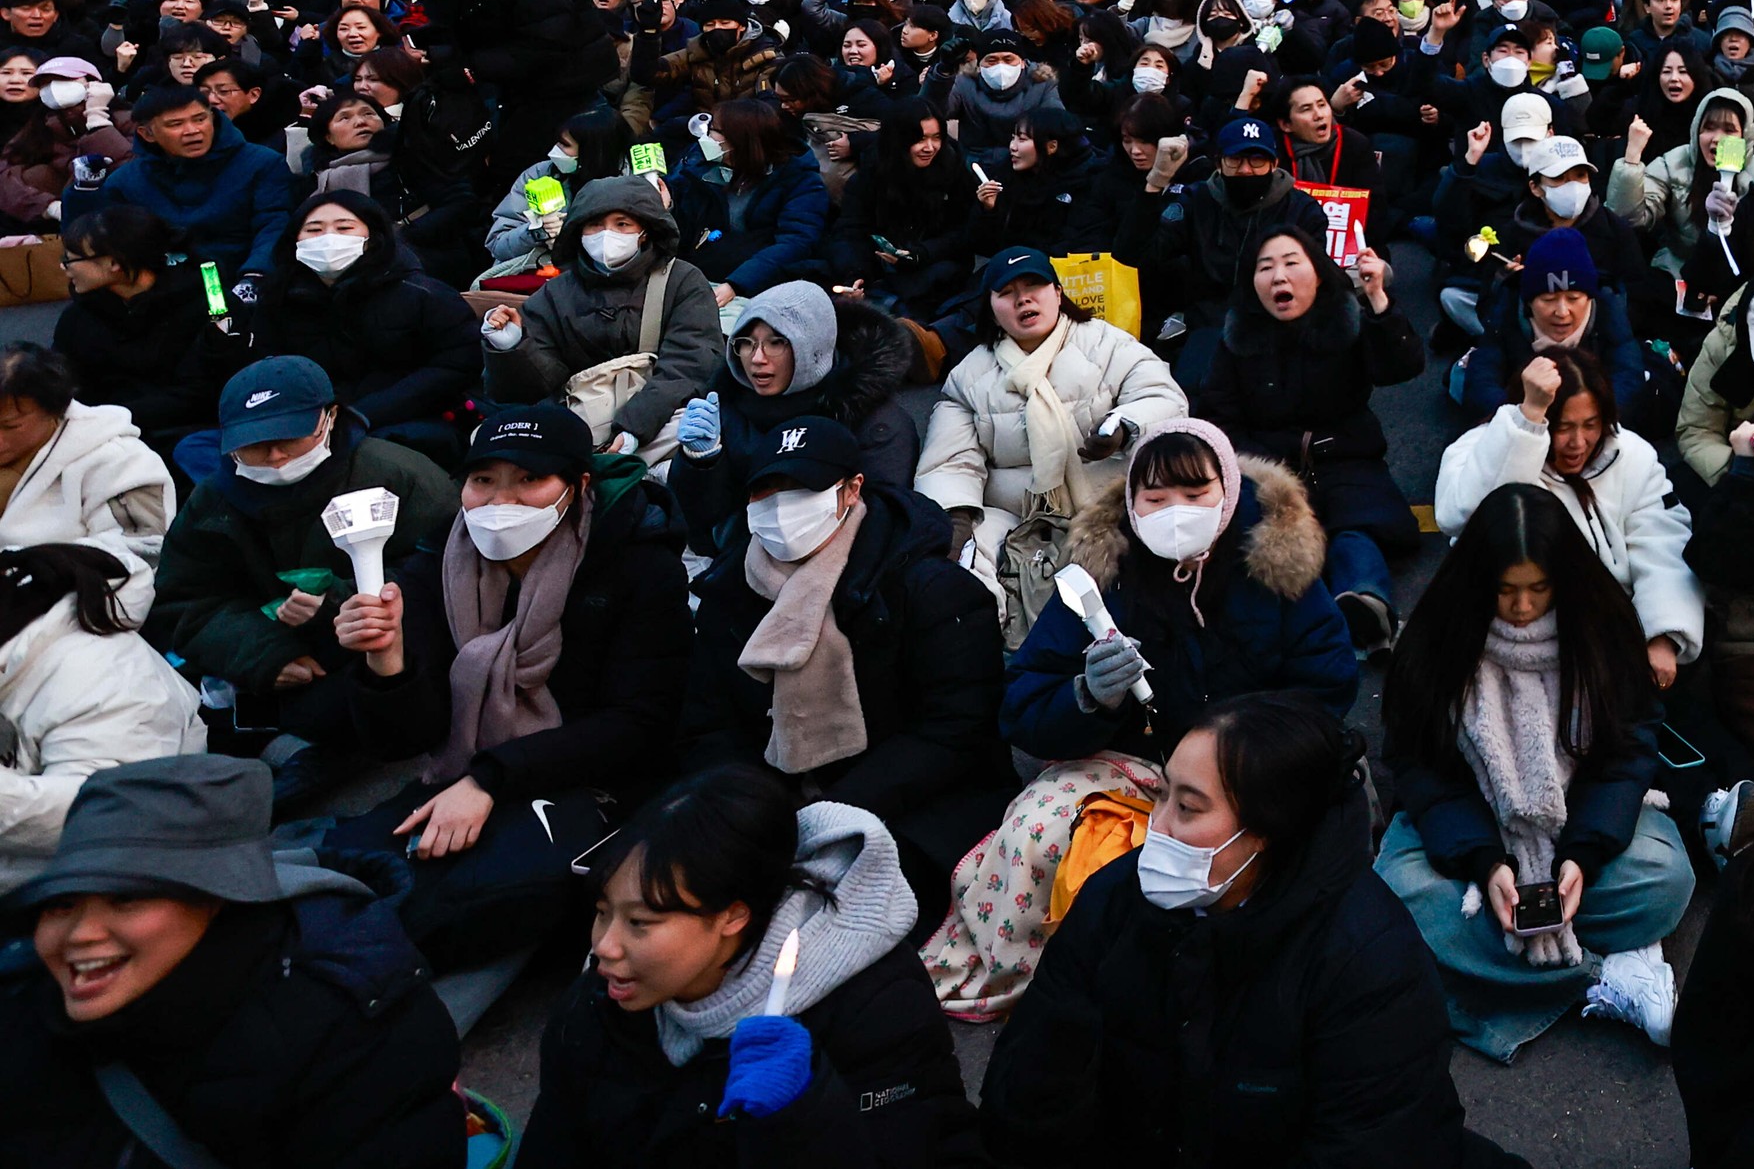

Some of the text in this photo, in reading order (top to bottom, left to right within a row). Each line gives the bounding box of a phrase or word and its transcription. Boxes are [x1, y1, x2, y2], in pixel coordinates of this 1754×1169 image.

[456, 121, 492, 151] VALENTINO
[1243, 123, 1260, 138] NY
[1075, 295, 1105, 307] LOVE
[251, 391, 272, 402] NIKE
[504, 422, 531, 431] ODER
